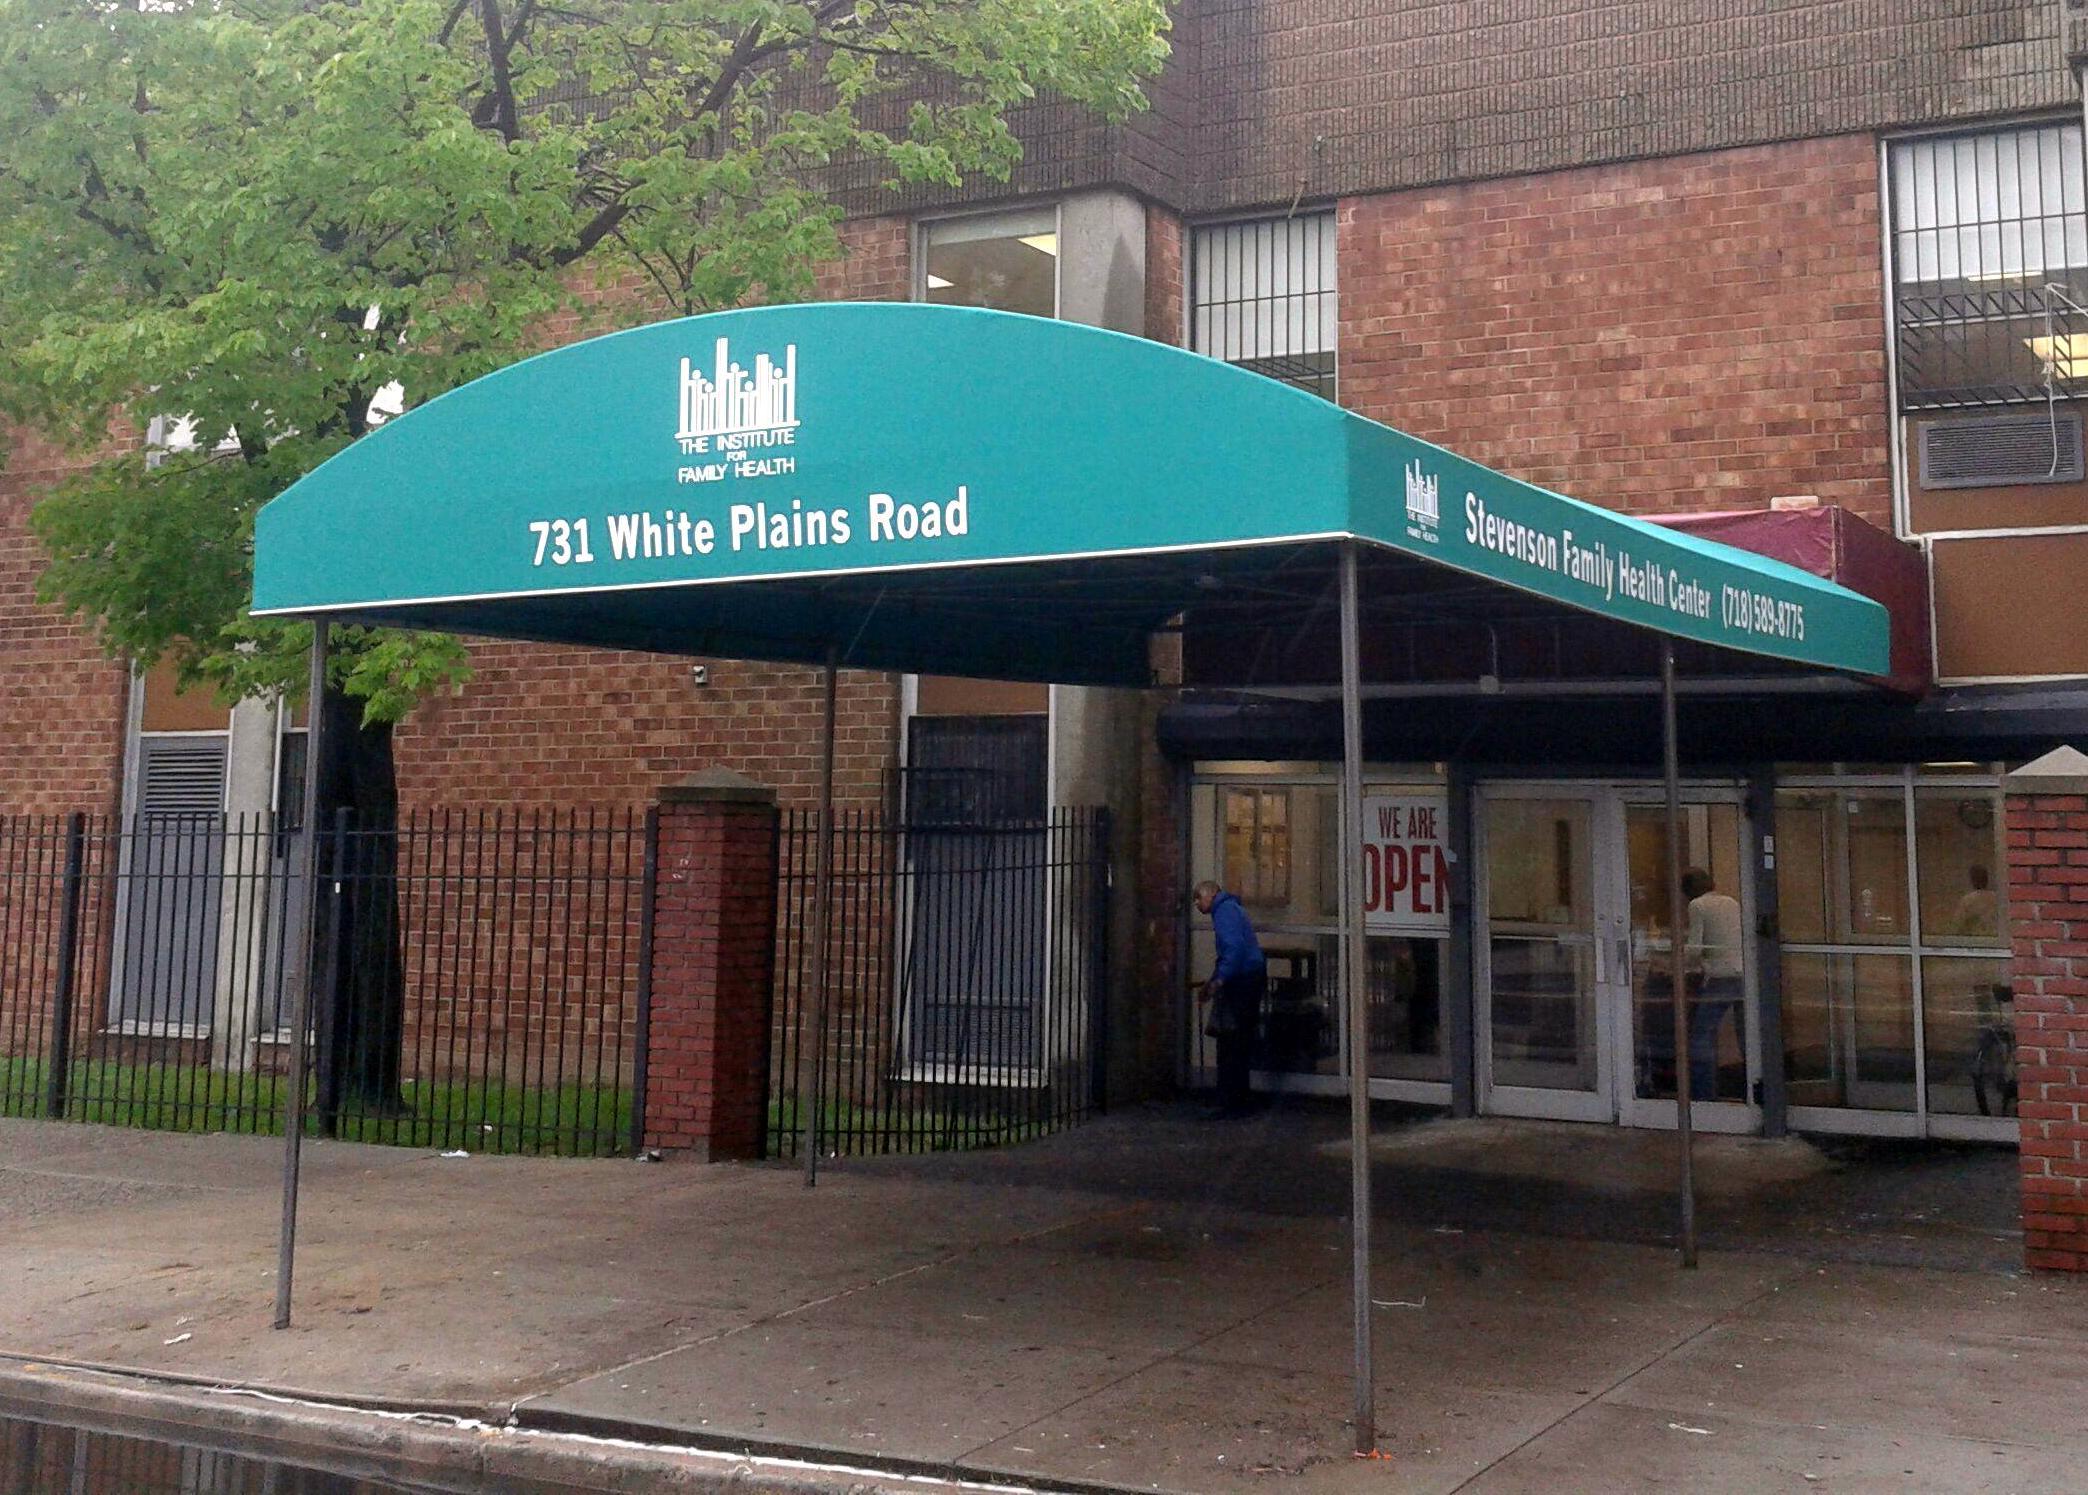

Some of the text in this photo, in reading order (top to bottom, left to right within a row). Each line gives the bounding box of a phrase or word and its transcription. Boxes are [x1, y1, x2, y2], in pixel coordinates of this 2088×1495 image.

[678, 427, 795, 455] THE INSTITUTE
[726, 450, 747, 462] FOR
[678, 457, 795, 484] FAMILY HEALTH
[529, 486, 968, 566] 731 White Plains Road
[1465, 491, 1558, 571] Stevenson
[1563, 529, 1614, 601] Family
[1619, 551, 1665, 607] Health
[1668, 568, 1711, 619] Center
[1379, 806, 1438, 839] WE ARE
